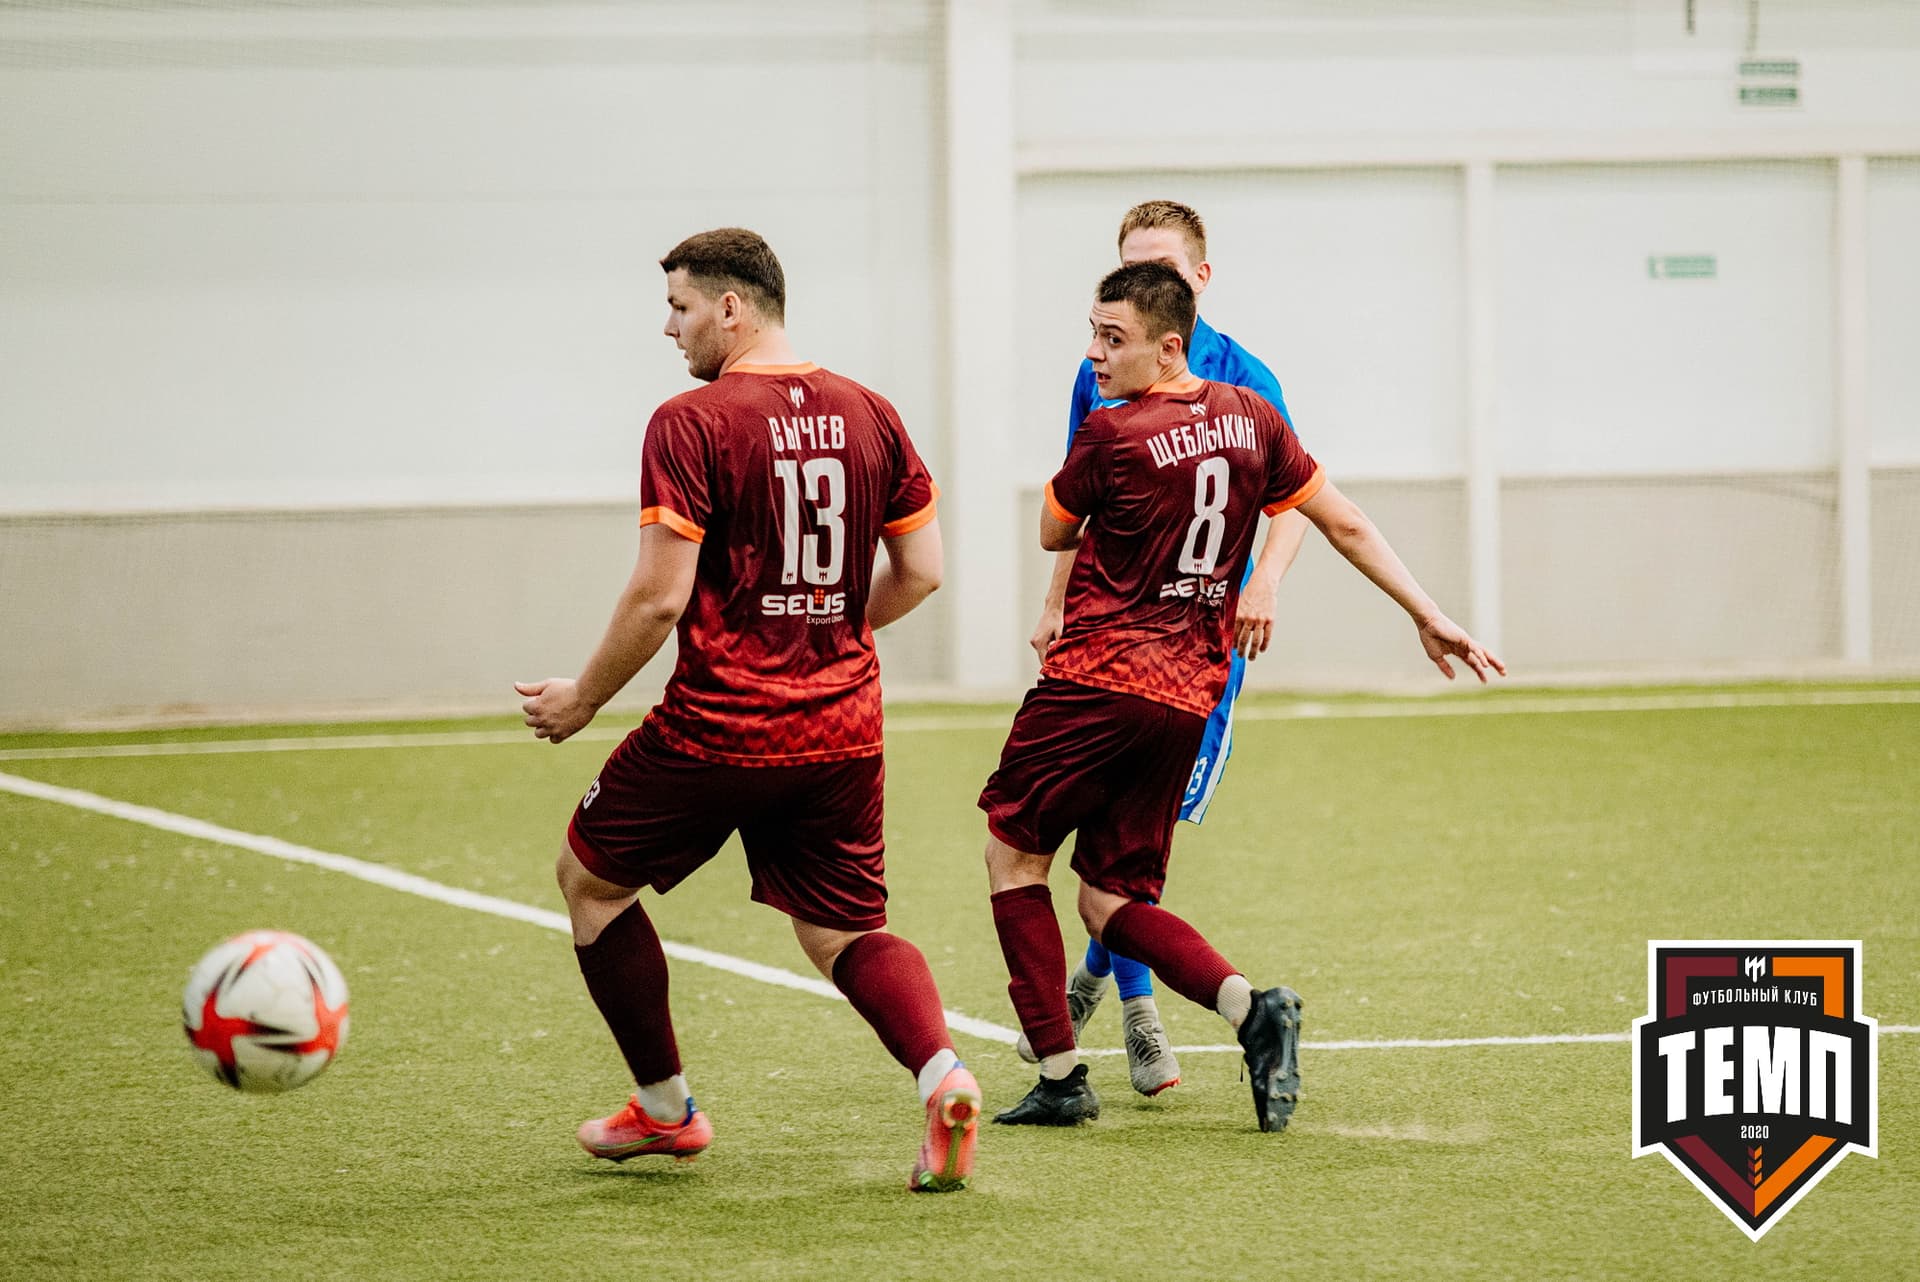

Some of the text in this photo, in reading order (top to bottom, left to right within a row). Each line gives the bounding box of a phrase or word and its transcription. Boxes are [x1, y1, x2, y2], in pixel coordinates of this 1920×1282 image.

[768, 415, 846, 452] СЫЧЕВ
[1146, 414, 1257, 469] ЩЕБЛЫКИН
[774, 457, 846, 586] 13
[1178, 456, 1230, 575] 8
[761, 591, 846, 616] SEUS
[806, 615, 831, 626] Export
